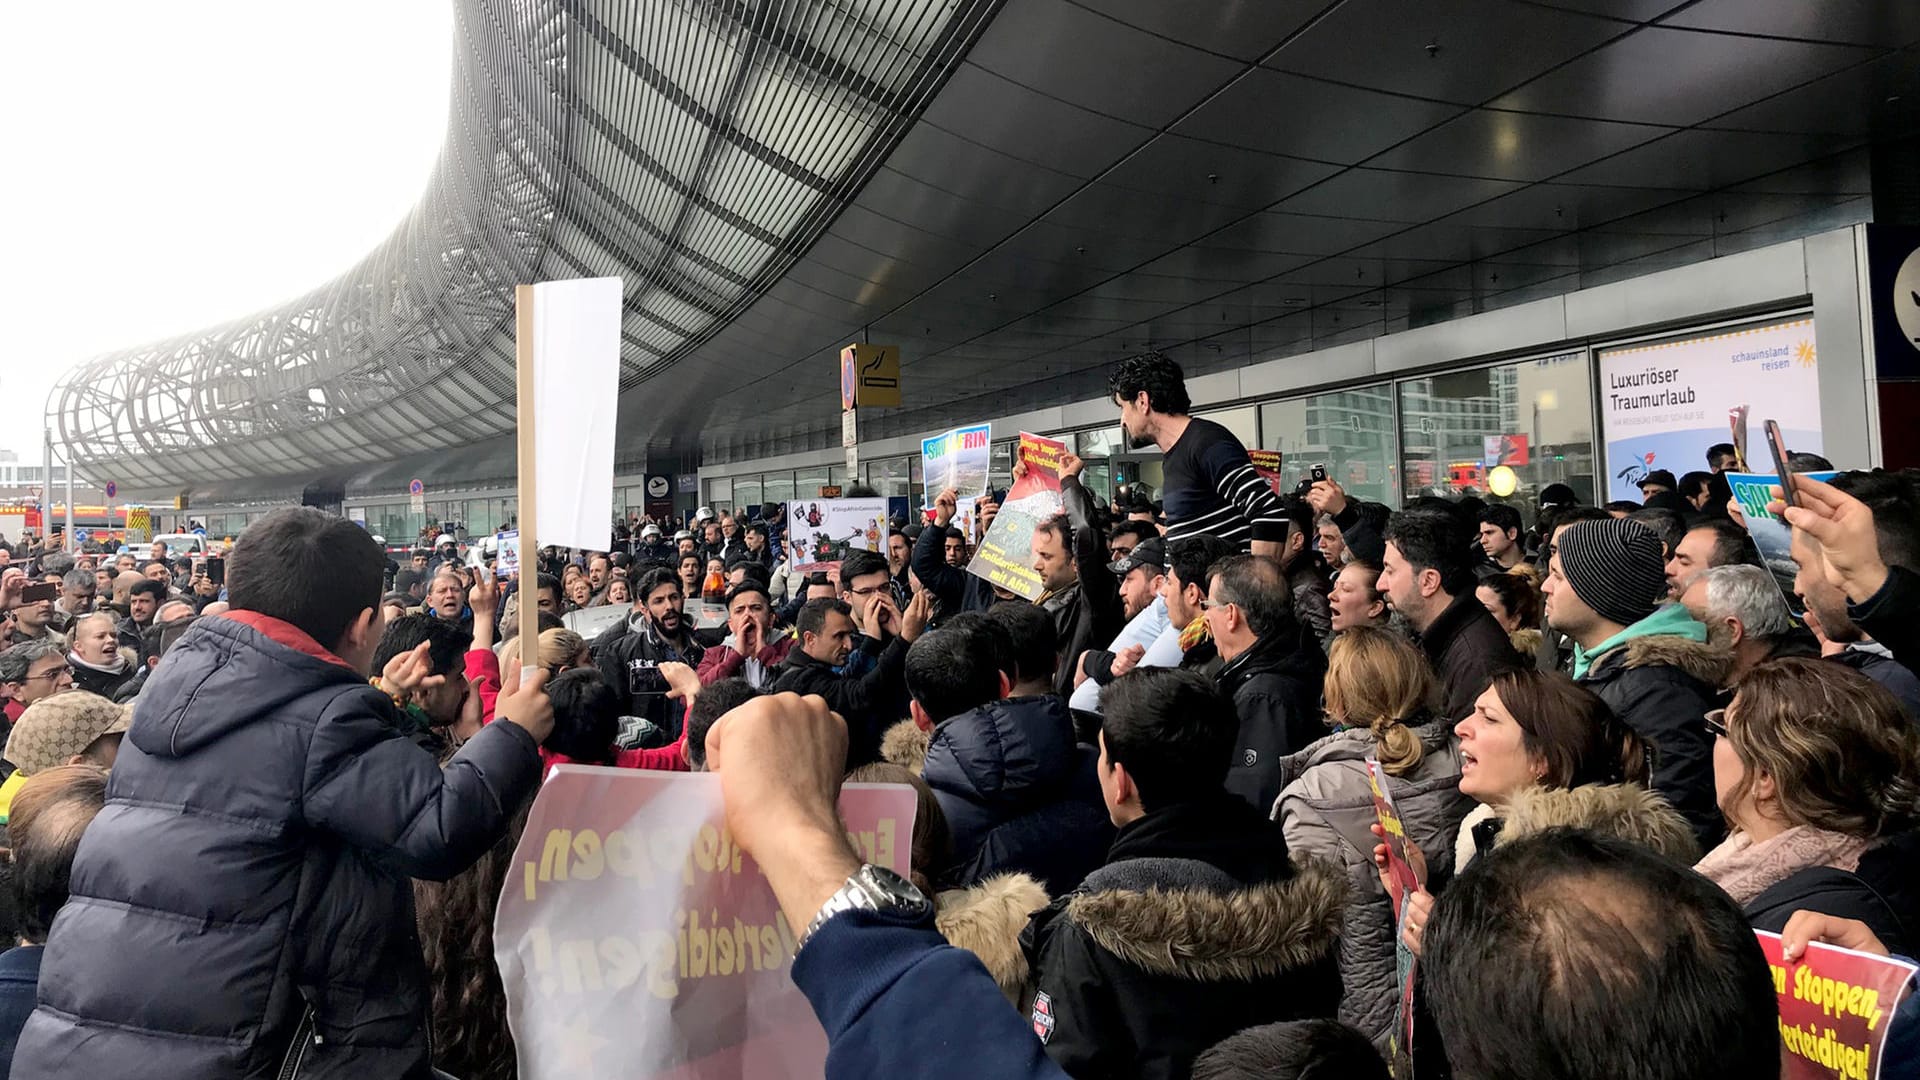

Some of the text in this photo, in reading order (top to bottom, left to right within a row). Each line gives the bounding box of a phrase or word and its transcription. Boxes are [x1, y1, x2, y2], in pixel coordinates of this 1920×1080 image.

[1731, 345, 1790, 364] schauinsland
[1761, 359, 1791, 372] reisen
[1611, 367, 1680, 389] Luxuriöser
[1610, 386, 1696, 411] Traumurlaub
[989, 569, 1032, 596] mit Afrin
[1793, 964, 1883, 1031] Stoppen,
[1778, 1014, 1871, 1080] erteidigen!
